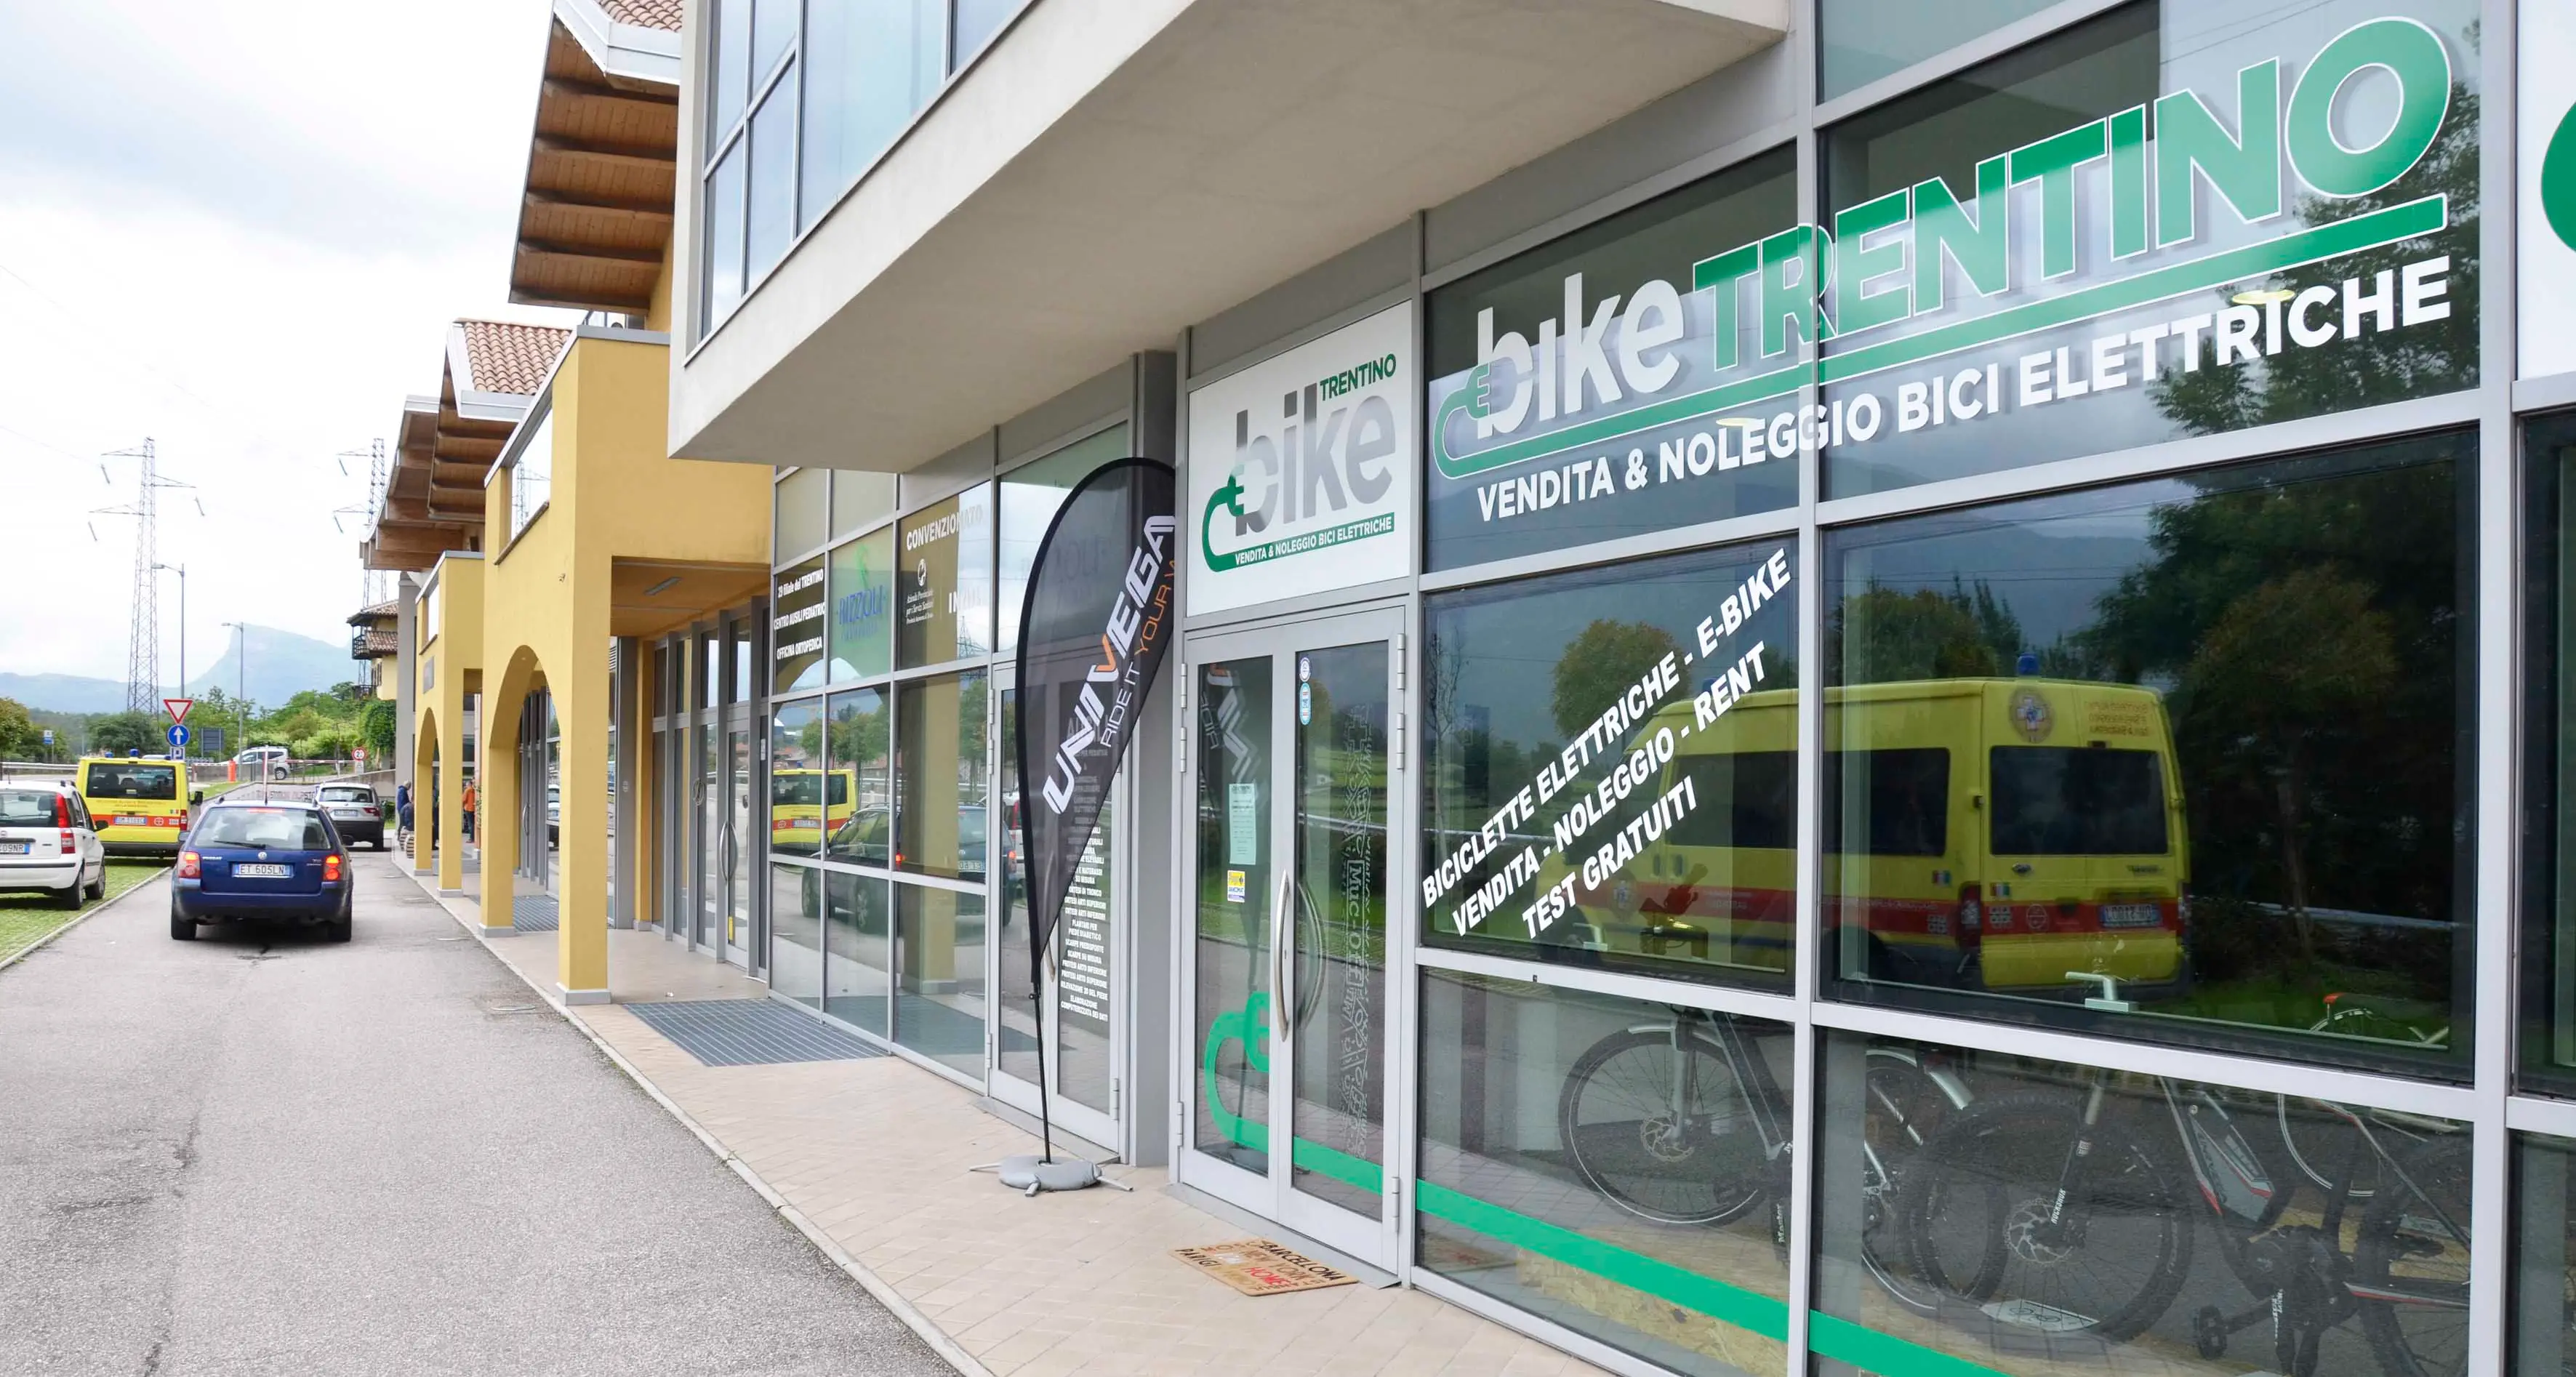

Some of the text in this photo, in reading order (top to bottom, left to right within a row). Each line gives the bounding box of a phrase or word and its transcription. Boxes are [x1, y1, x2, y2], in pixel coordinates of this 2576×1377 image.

[1693, 16, 2452, 372] TRENTINO
[1320, 353, 1397, 401] TRENTINO
[1477, 255, 2451, 522] VENDITA & NOLEGGIO BICI ELETTRICHE
[1235, 516, 1392, 565] VENDITA & NOLEGGIO BICI ELETTRICHE
[774, 614, 789, 630] CENTRO
[777, 636, 822, 660] OFFICINA ORTOPEDICA
[1042, 515, 1176, 814] UNIVEGA
[1100, 585, 1172, 747] RIDE IT YOUR
[1422, 784, 1536, 908] BICICLETTE
[1536, 651, 1680, 806] ELETTRICHE
[1684, 653, 1693, 665] -
[1696, 547, 1792, 658] E-BIKE
[1452, 641, 1765, 938] VENDITA - NOLEGGIO - RENT
[1522, 775, 1697, 939] TEST GRATUITI
[1175, 1248, 1223, 1267] PARIGI
[1259, 1244, 1347, 1282] BARCELLONA
